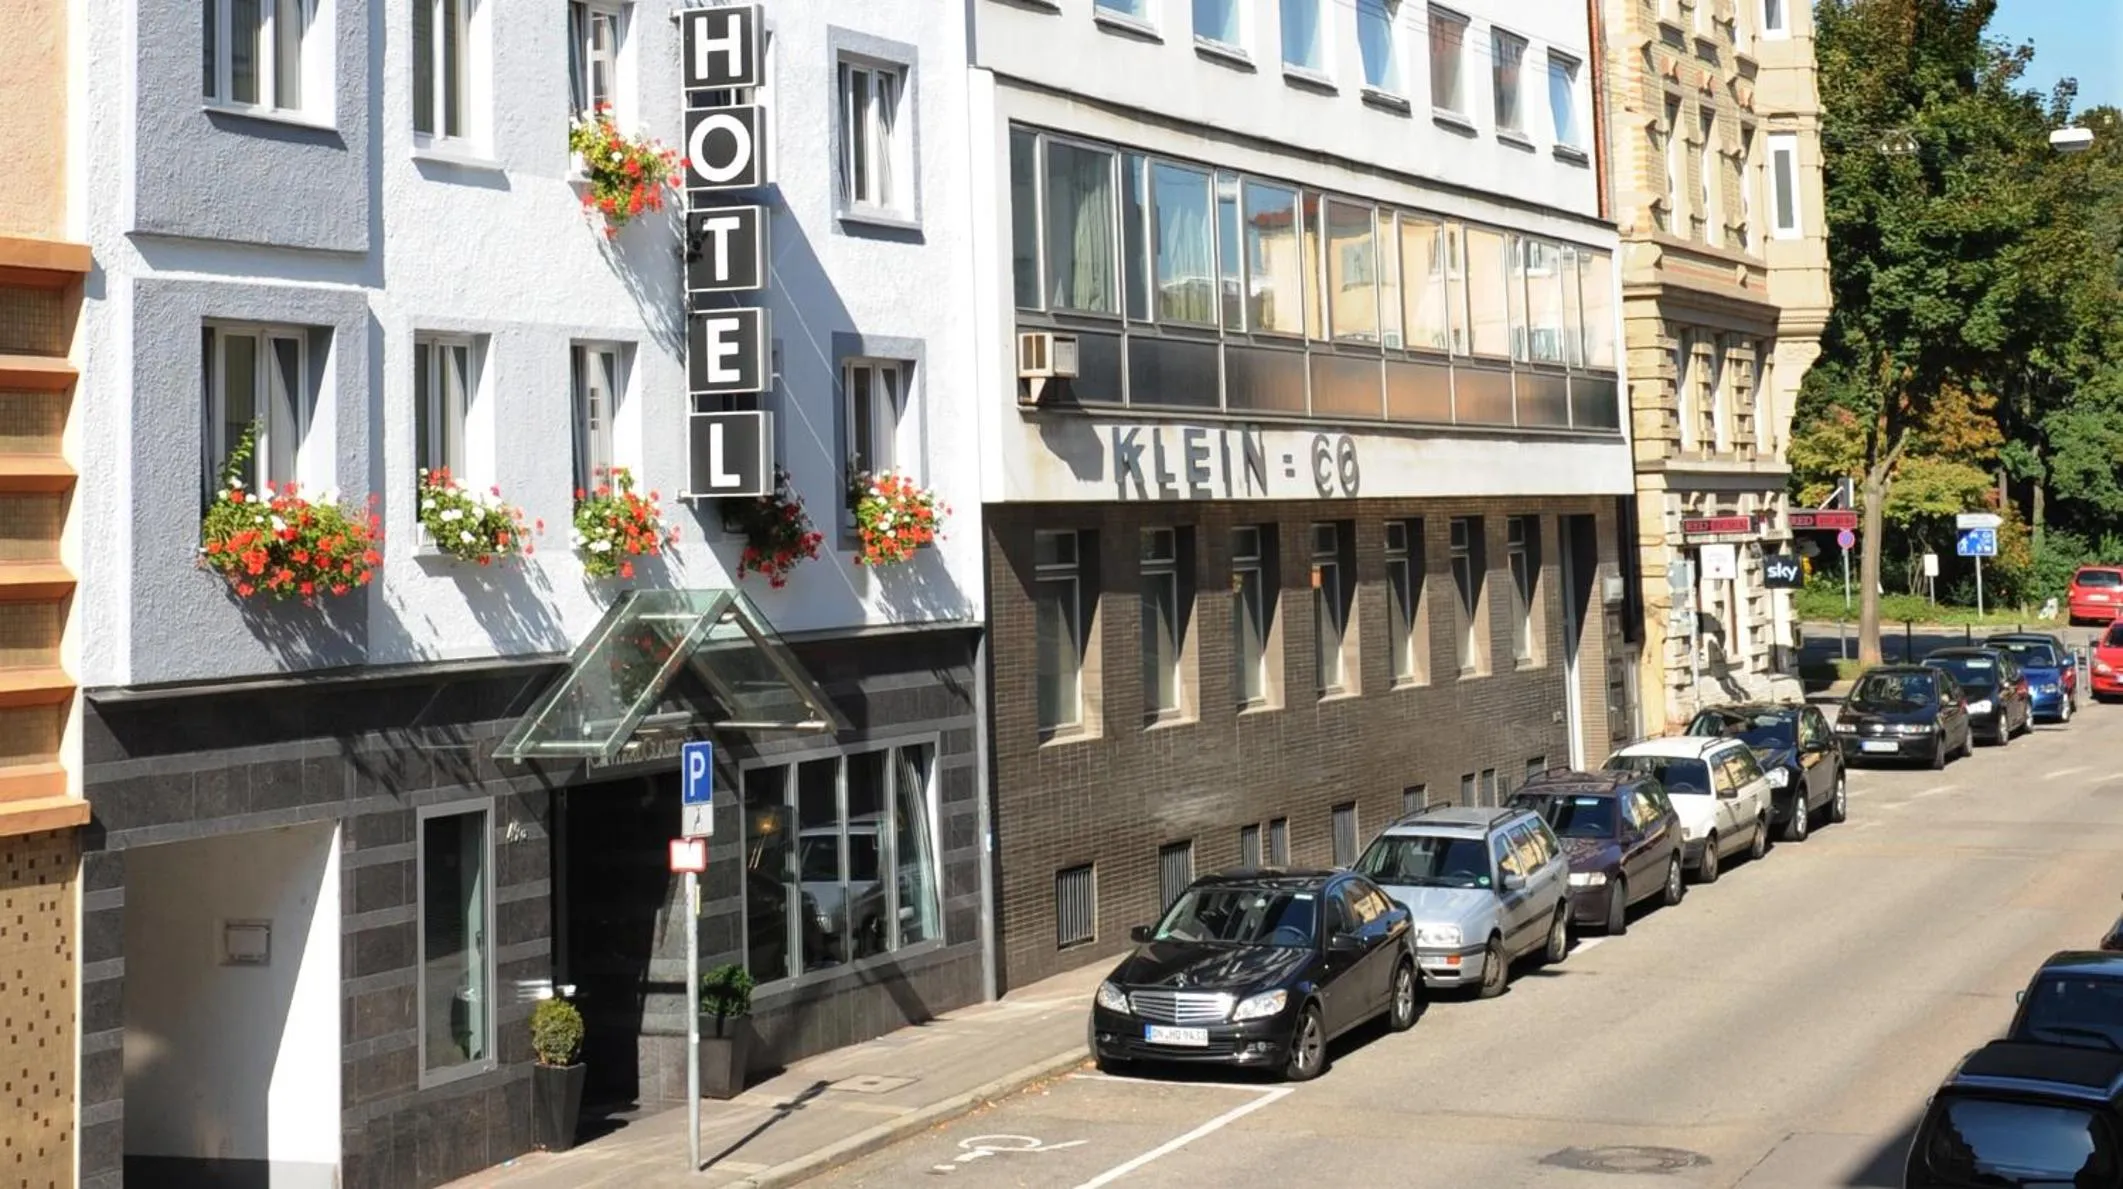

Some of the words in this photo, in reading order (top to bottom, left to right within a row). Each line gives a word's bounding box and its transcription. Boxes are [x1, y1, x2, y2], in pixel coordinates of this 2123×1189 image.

[688, 13, 752, 488] HOTEL
[1112, 424, 1268, 493] KLEIN
[1311, 432, 1360, 491] CO
[1767, 562, 1798, 581] sky
[689, 751, 706, 797] P
